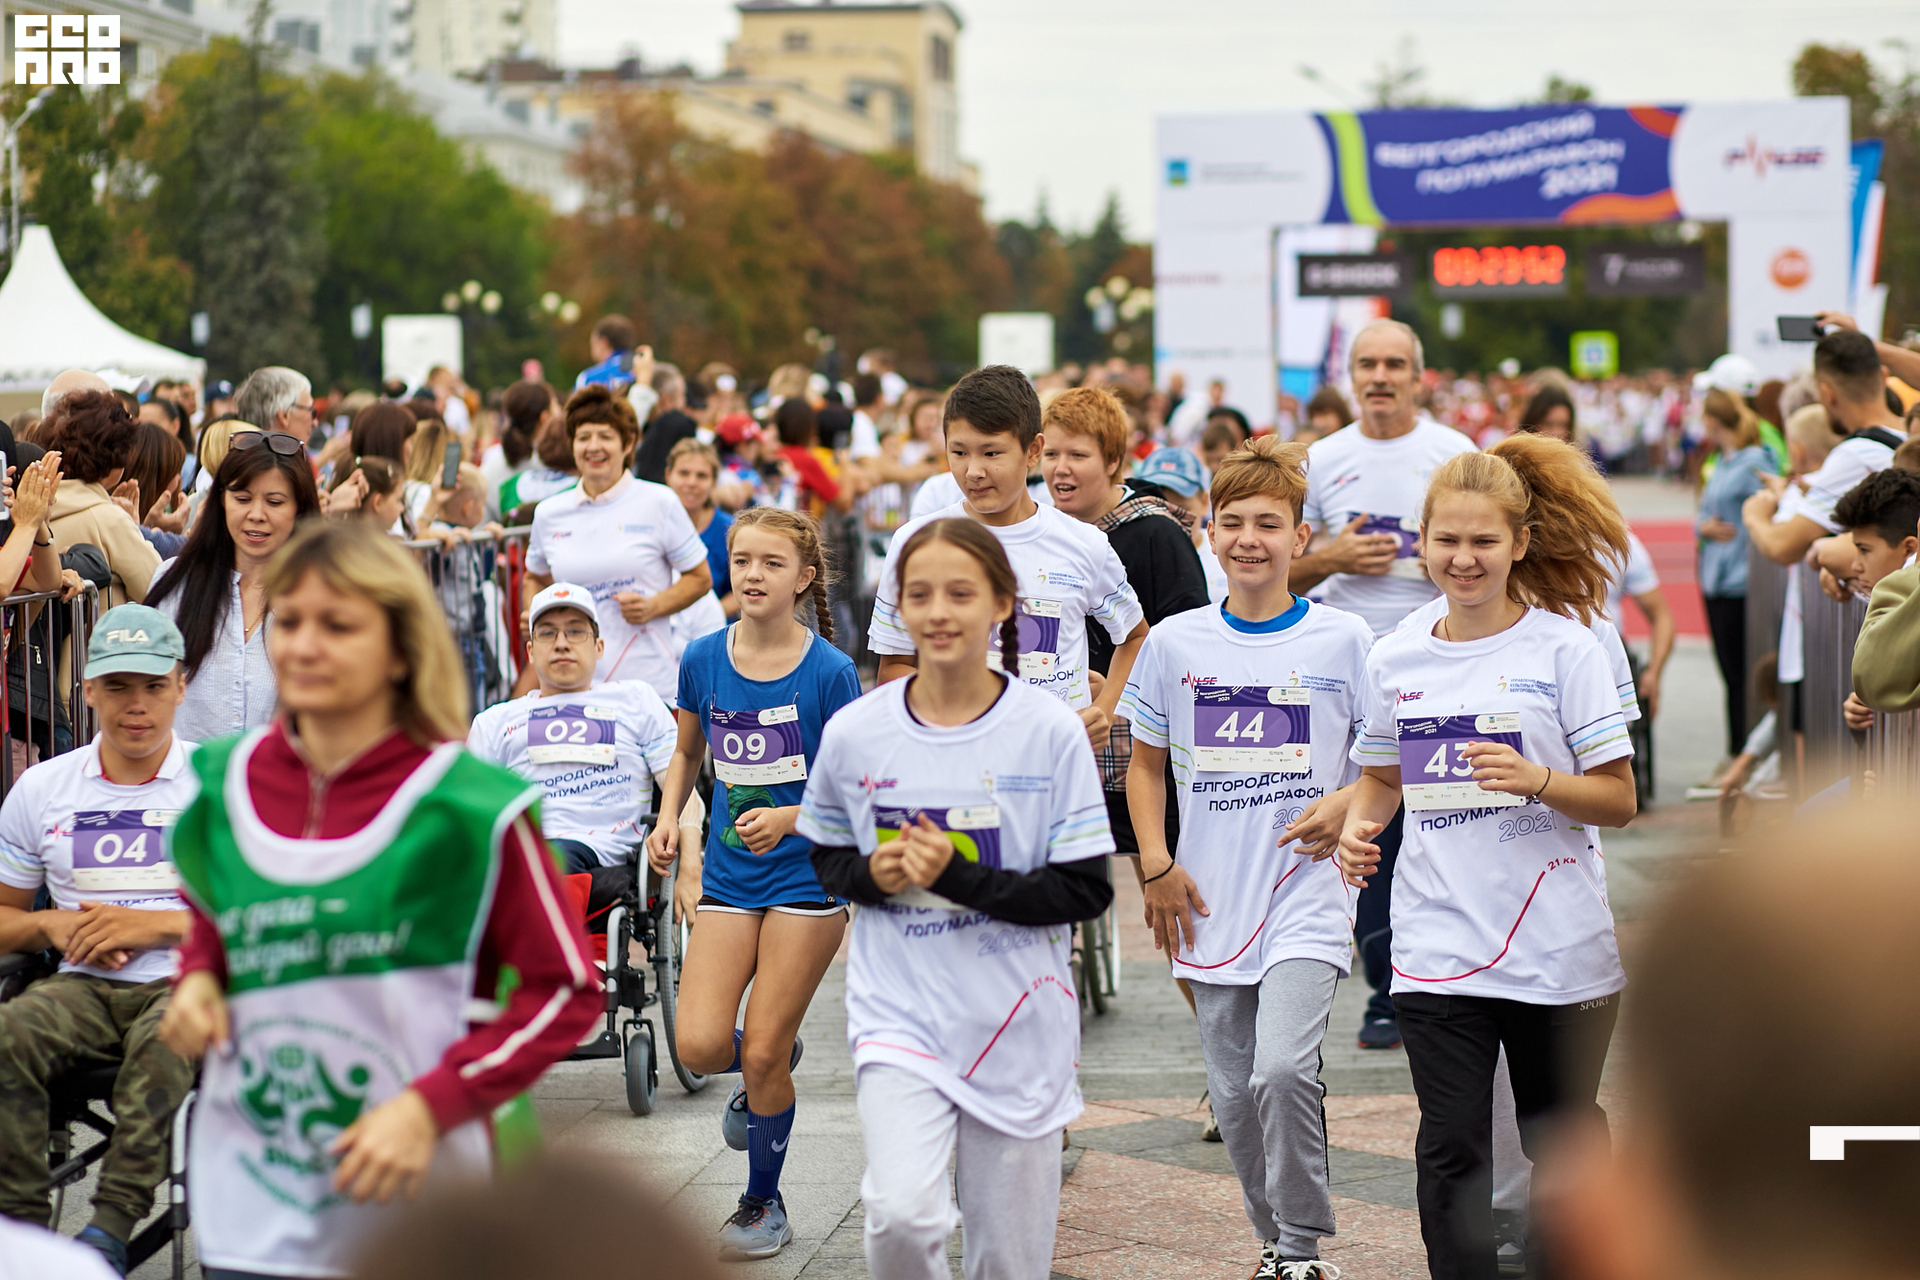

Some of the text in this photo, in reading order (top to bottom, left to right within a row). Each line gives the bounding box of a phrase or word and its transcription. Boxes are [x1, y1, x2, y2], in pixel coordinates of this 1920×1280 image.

[106, 629, 149, 644] FILA
[545, 719, 588, 743] 02
[1214, 711, 1264, 742] 44
[723, 732, 766, 761] 09
[532, 758, 619, 787] ГОРОДСКИЙ
[1424, 743, 1474, 777] 43
[1192, 766, 1313, 792] ЕЛГОРОДСКИЙ
[1209, 787, 1324, 811] ПОЛУМАРАФОН
[1272, 806, 1305, 829] 20
[1499, 810, 1557, 842] 2021
[93, 832, 147, 864] 04
[1547, 858, 1560, 871] 21
[1580, 996, 1609, 1011] SPORT
